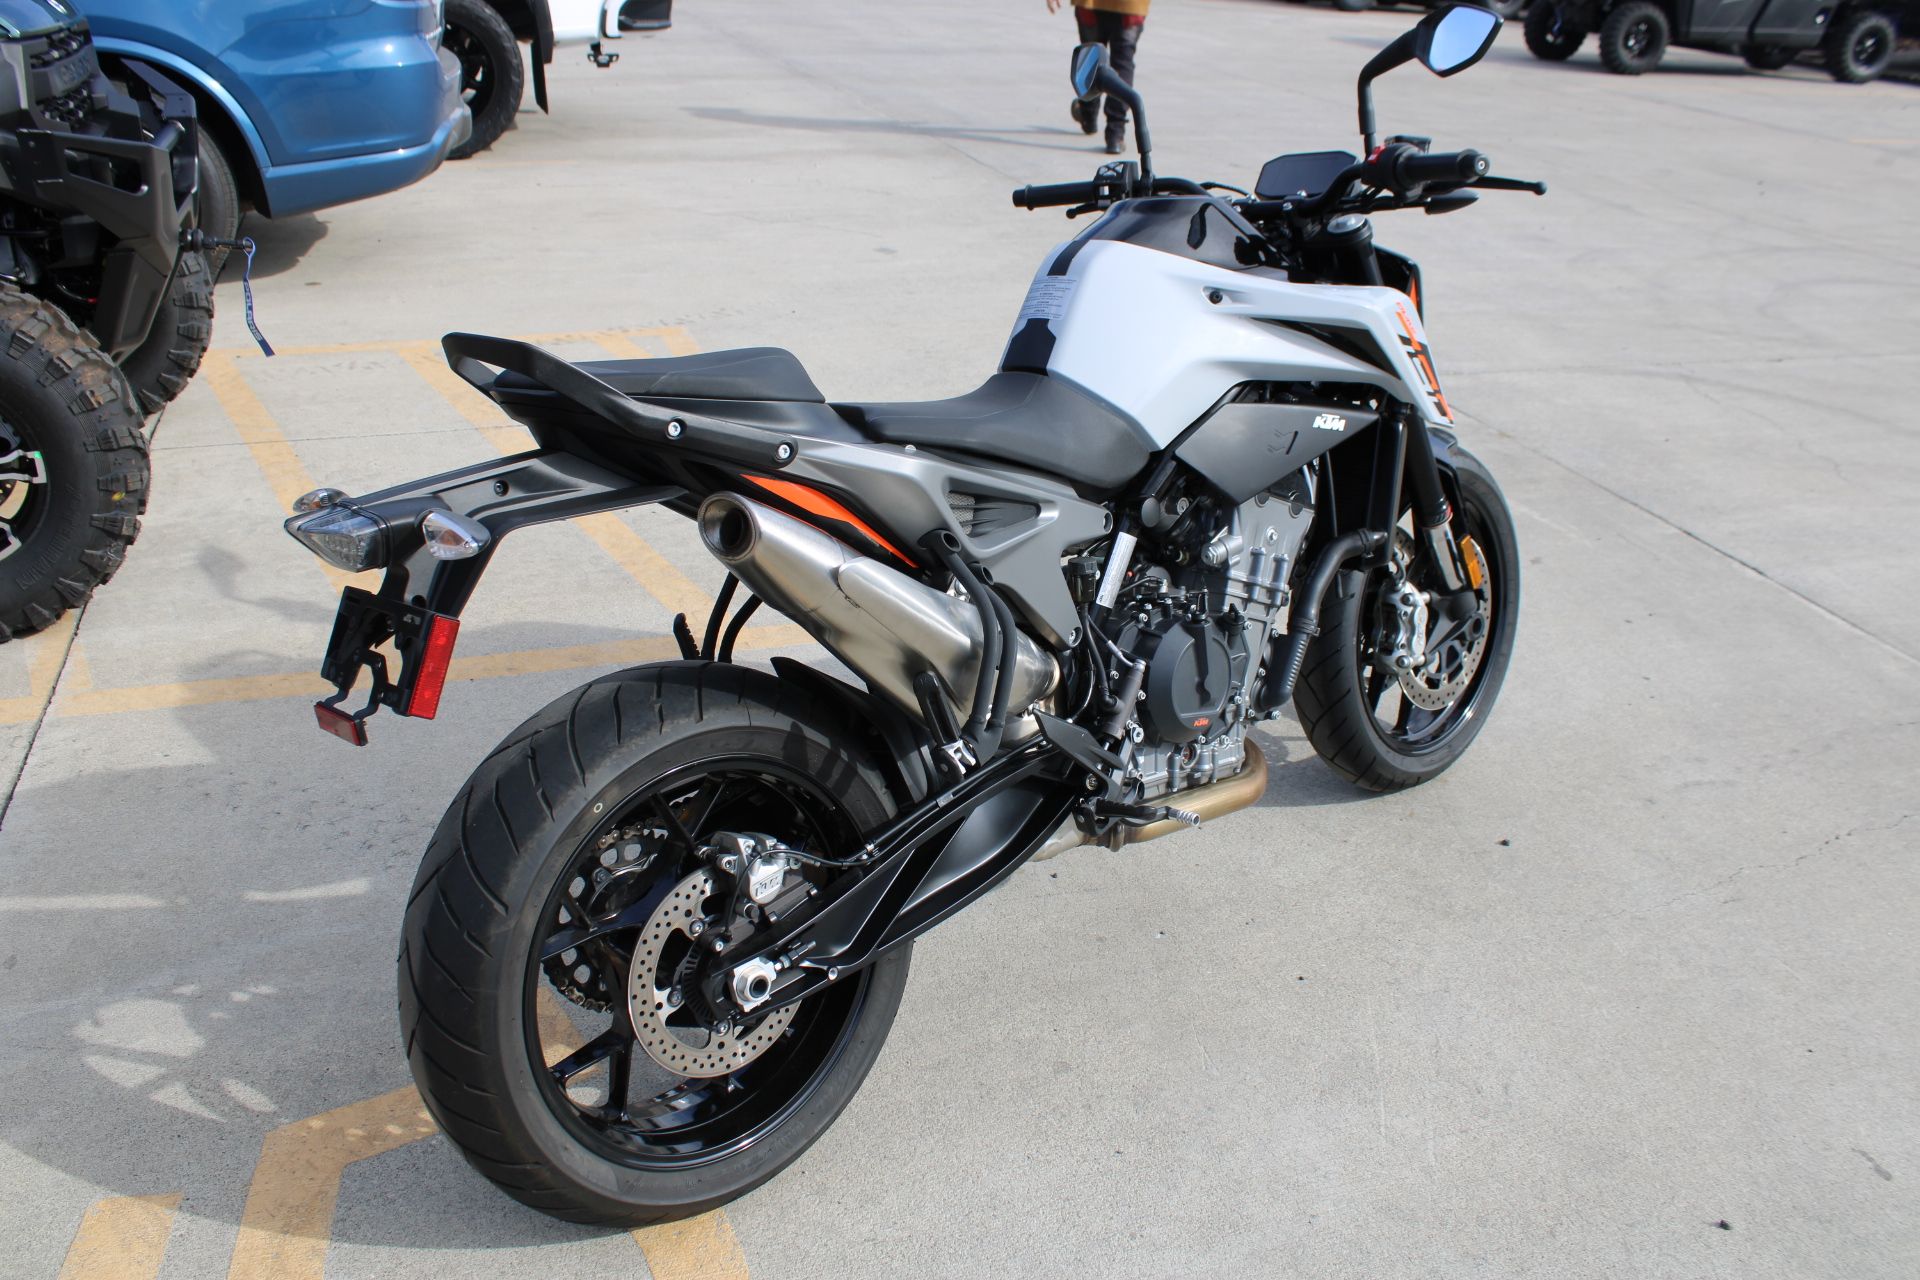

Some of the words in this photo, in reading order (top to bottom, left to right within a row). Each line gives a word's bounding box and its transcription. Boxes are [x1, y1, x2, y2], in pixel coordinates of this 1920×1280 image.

[243, 281, 263, 341] POLARIS
[1312, 413, 1346, 431] KTM
[1193, 717, 1210, 728] KTM
